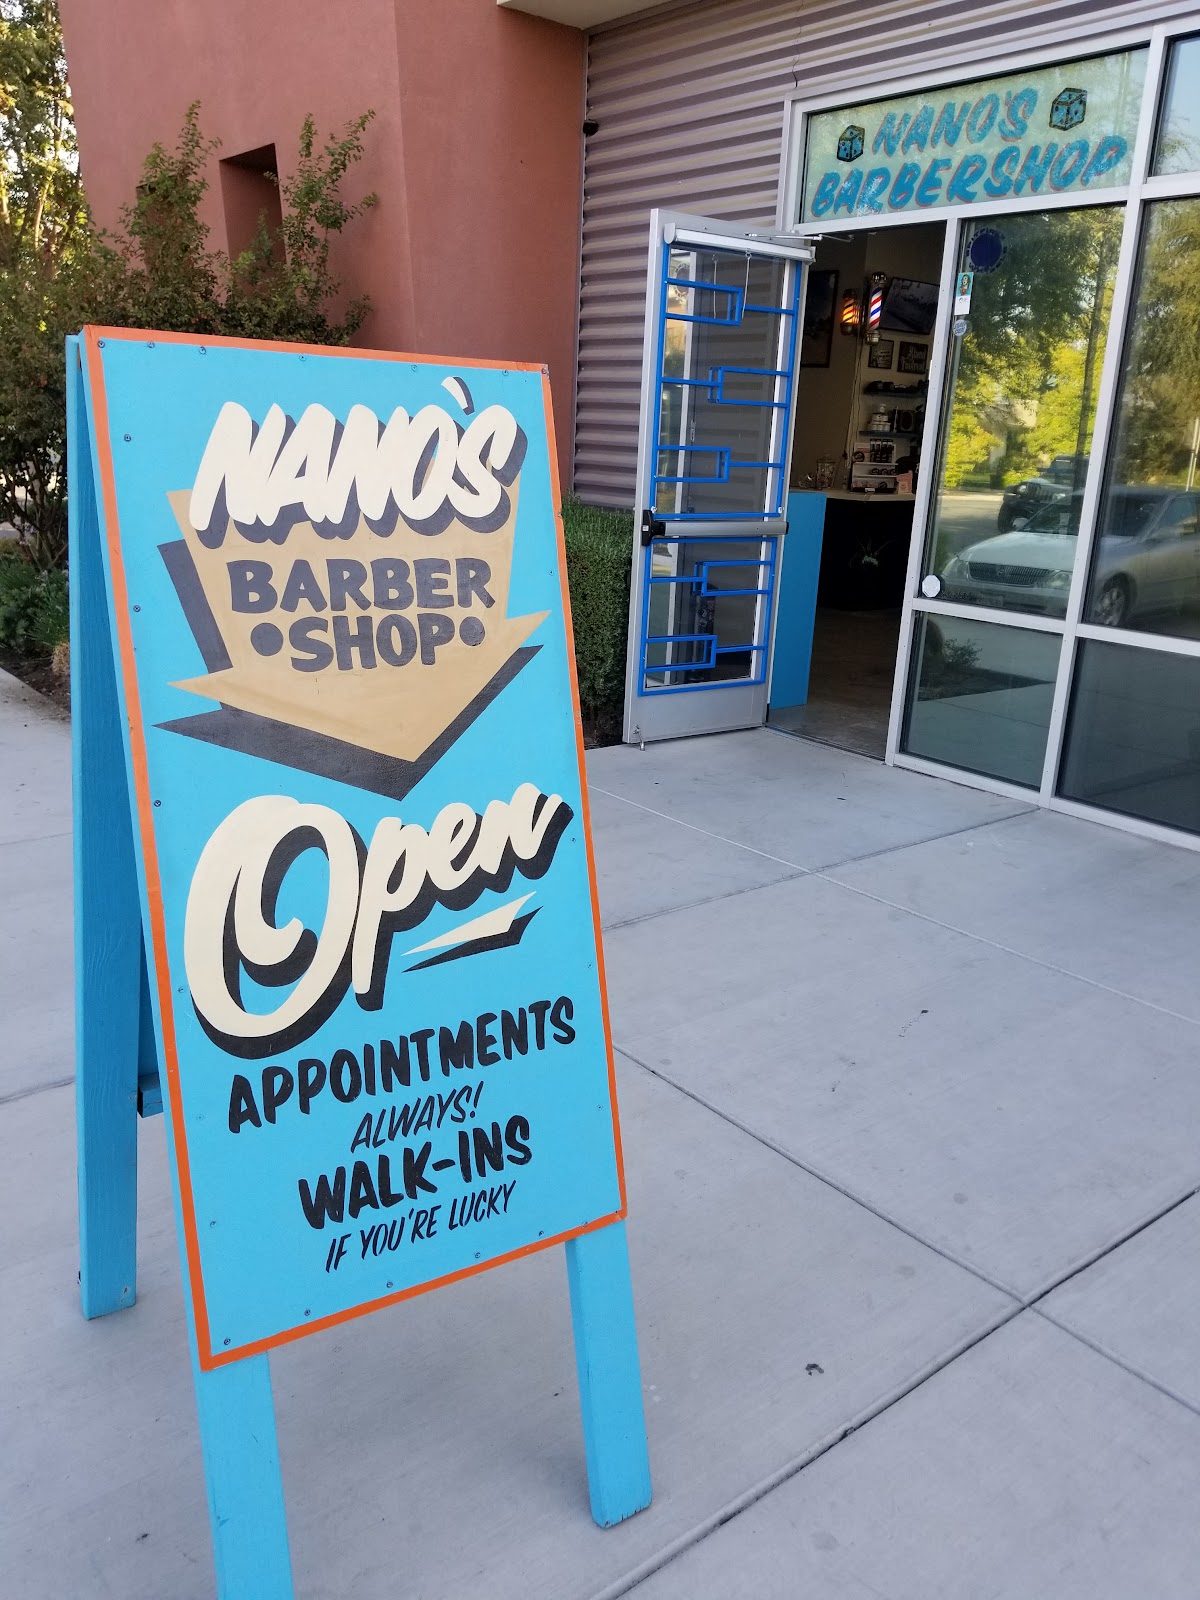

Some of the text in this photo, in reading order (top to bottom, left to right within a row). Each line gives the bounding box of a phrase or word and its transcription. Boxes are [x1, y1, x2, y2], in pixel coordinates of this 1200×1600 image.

[871, 87, 1039, 157] NANO'S
[810, 134, 1128, 218] BARBERSHOP
[189, 376, 525, 546] NANO'S
[226, 557, 496, 613] BARBER
[288, 615, 455, 673] SHOP
[183, 782, 572, 1056] Open
[228, 996, 576, 1134] APPOINTMENTS
[350, 1080, 484, 1153] ALWAYS!
[298, 1115, 532, 1230] WALK-INS
[325, 1180, 517, 1273] IF YOU'RE LUCKY
